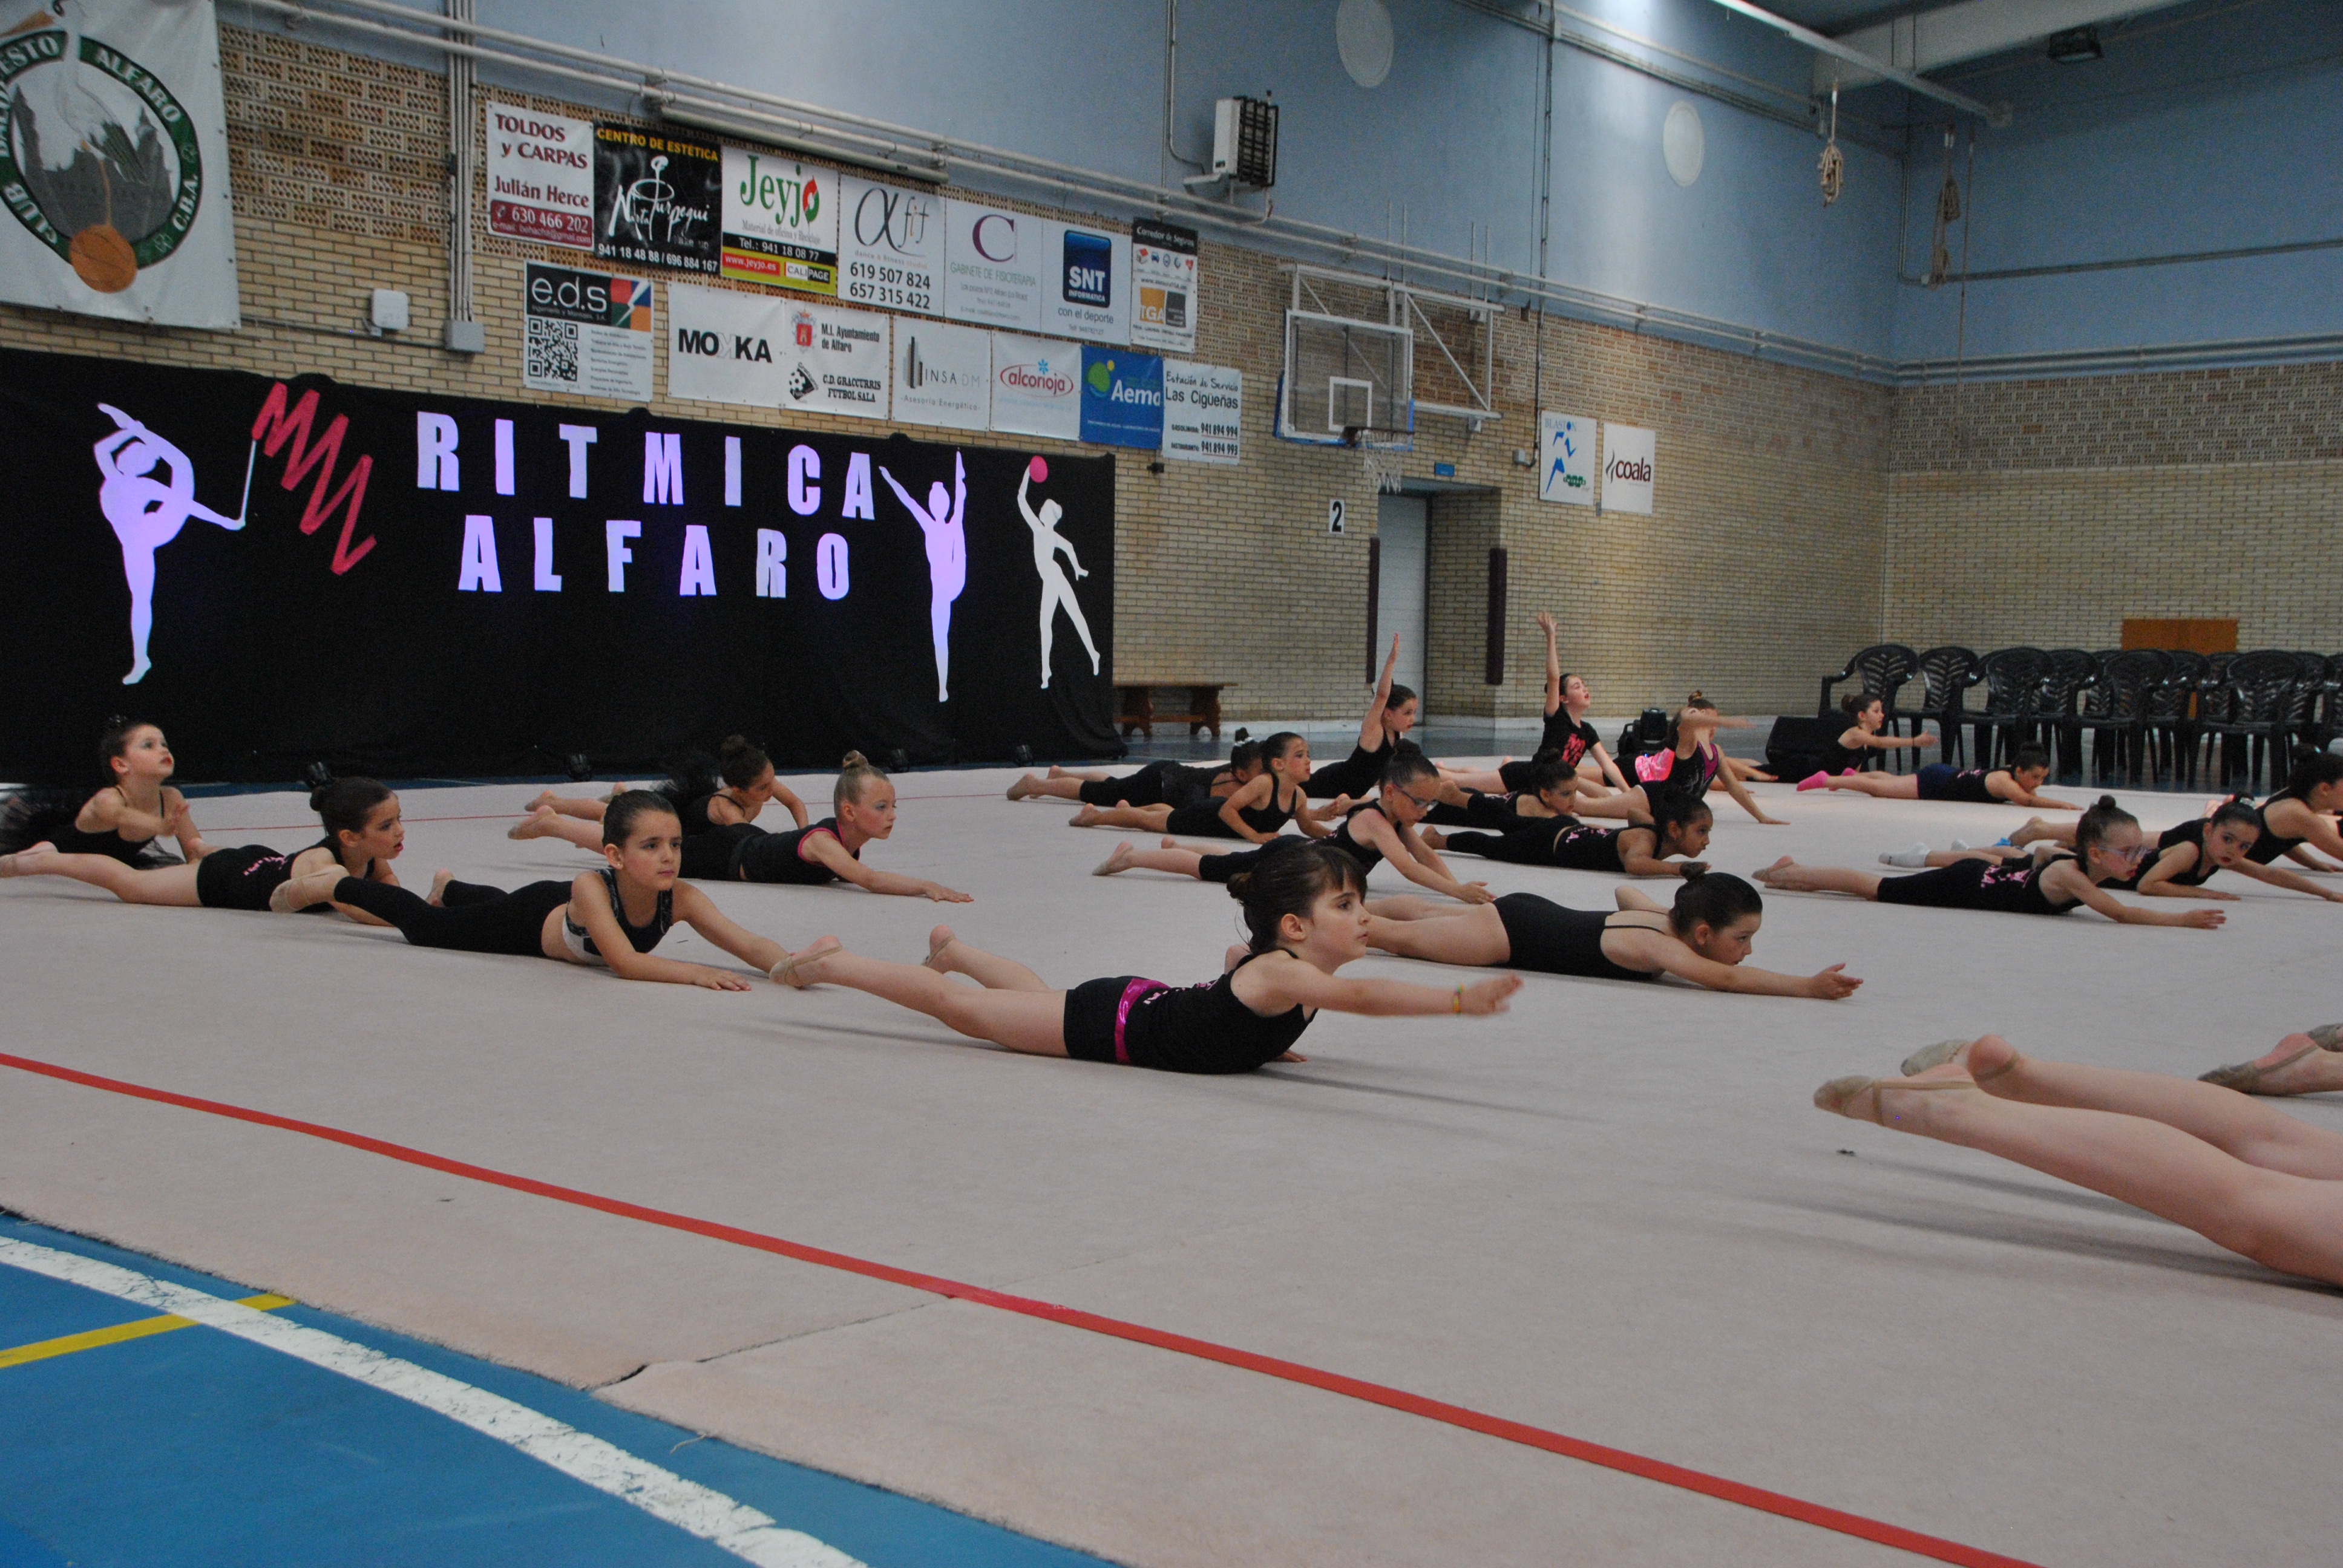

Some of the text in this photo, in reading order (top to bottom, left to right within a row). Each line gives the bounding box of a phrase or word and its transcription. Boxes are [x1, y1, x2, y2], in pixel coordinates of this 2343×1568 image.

[94, 48, 182, 122] ALFARO
[494, 113, 566, 142] TOLDOS
[597, 127, 646, 147] CENTRO
[649, 137, 664, 150] DE
[502, 142, 588, 169] y CARPAS
[494, 175, 590, 208] Julián Herce
[740, 154, 821, 228] Jeyjo
[4, 183, 58, 244] CLUB
[512, 206, 589, 234] 630 466 202
[762, 241, 779, 255] 941
[782, 245, 793, 257] 18
[795, 247, 807, 260] 08
[808, 249, 819, 261] 77
[972, 214, 1015, 263] C
[598, 243, 616, 256] 941
[620, 246, 632, 258] 18
[634, 248, 647, 261] 48
[648, 250, 660, 263] 88
[666, 252, 683, 266] 696
[684, 256, 700, 269] 884
[702, 260, 718, 272] 167
[725, 255, 777, 271] www.jeyjo.es
[855, 250, 874, 259] dance
[787, 264, 830, 281] CALIPAGE
[850, 262, 931, 290] 619 507 824
[950, 261, 1036, 286] GABINETE DE FISIOTERAPIA
[1069, 265, 1106, 293] SNT
[531, 276, 608, 313] e.d.s
[850, 282, 875, 299] 657
[879, 286, 903, 304] 315
[906, 291, 931, 310] 422
[1068, 289, 1106, 302] INFORMATICA
[1058, 307, 1114, 325] con el deporte
[1140, 305, 1164, 322] TGA
[821, 323, 880, 343] M.I. Ayuntamiento
[821, 337, 852, 353] de Alfaro
[823, 374, 882, 390] C.D. GRACCURRIS
[1166, 371, 1197, 386] Estación
[1199, 376, 1208, 388] de
[1211, 377, 1239, 392] Servicio
[857, 391, 876, 403] SALA
[1165, 387, 1239, 410] Las Cigüeñas
[1201, 422, 1211, 434] 941
[1213, 423, 1224, 436] 894
[1226, 425, 1238, 437] 994
[1201, 440, 1212, 452] 941
[1213, 442, 1225, 454] 894
[1226, 443, 1238, 456] 993
[416, 410, 876, 520] RITMICA
[1615, 457, 1651, 482] coala
[1331, 500, 1343, 532] 2
[458, 515, 850, 601] ALFARO
